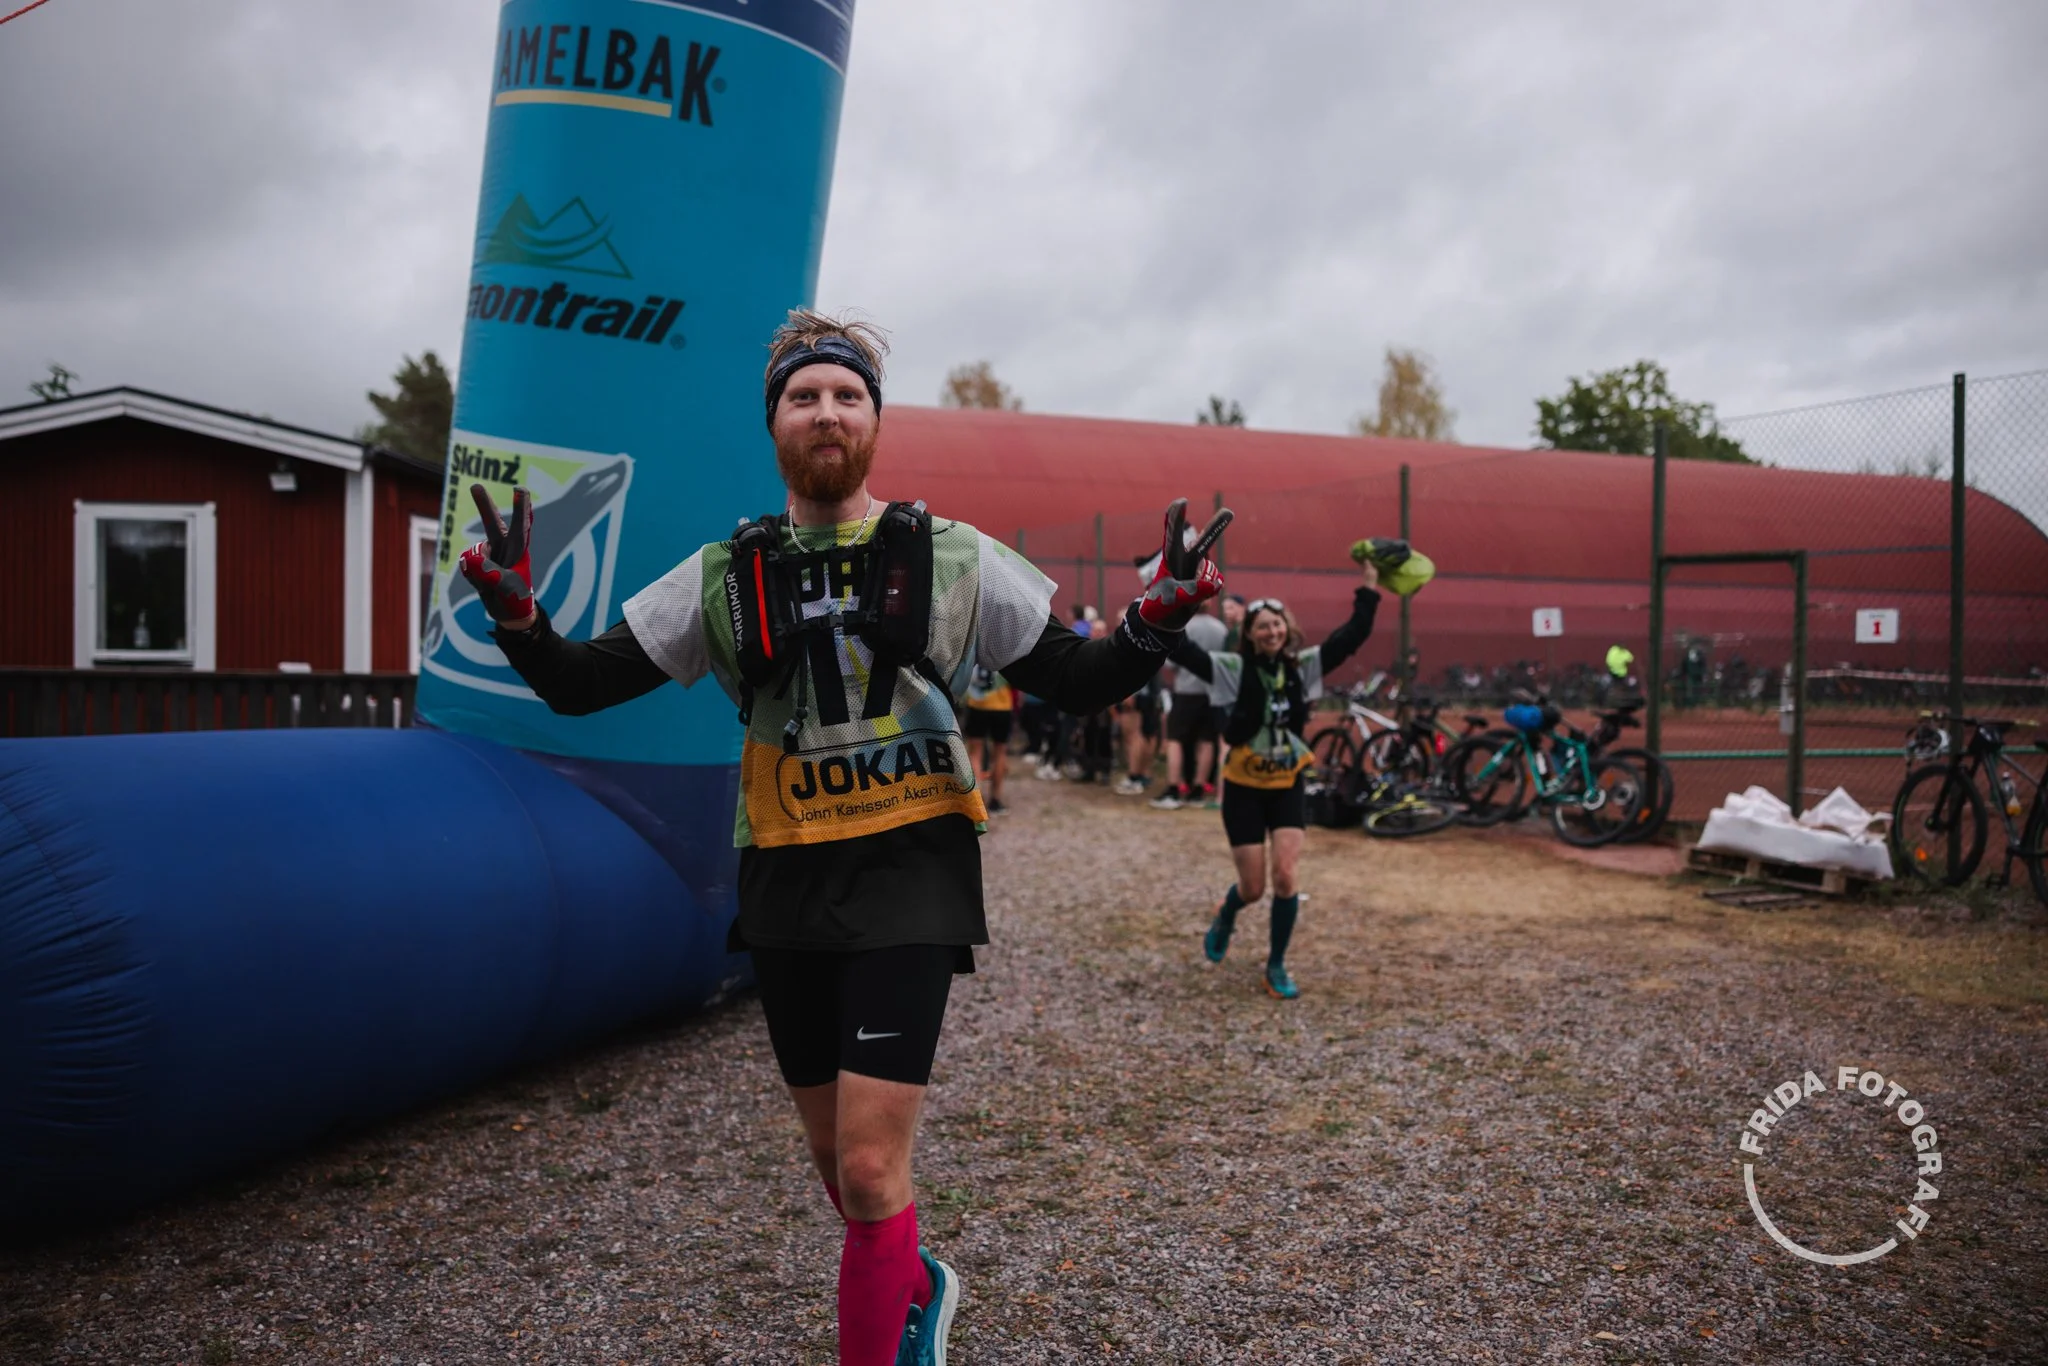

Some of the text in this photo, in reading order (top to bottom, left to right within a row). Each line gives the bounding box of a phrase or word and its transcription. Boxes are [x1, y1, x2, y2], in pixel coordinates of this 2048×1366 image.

[498, 24, 721, 127] AMELBAK
[726, 571, 743, 652] KARRIMOR
[790, 737, 955, 801] JOKAB
[796, 808, 832, 823] John
[836, 795, 899, 817] Karlsson
[903, 785, 940, 803] Åkeri
